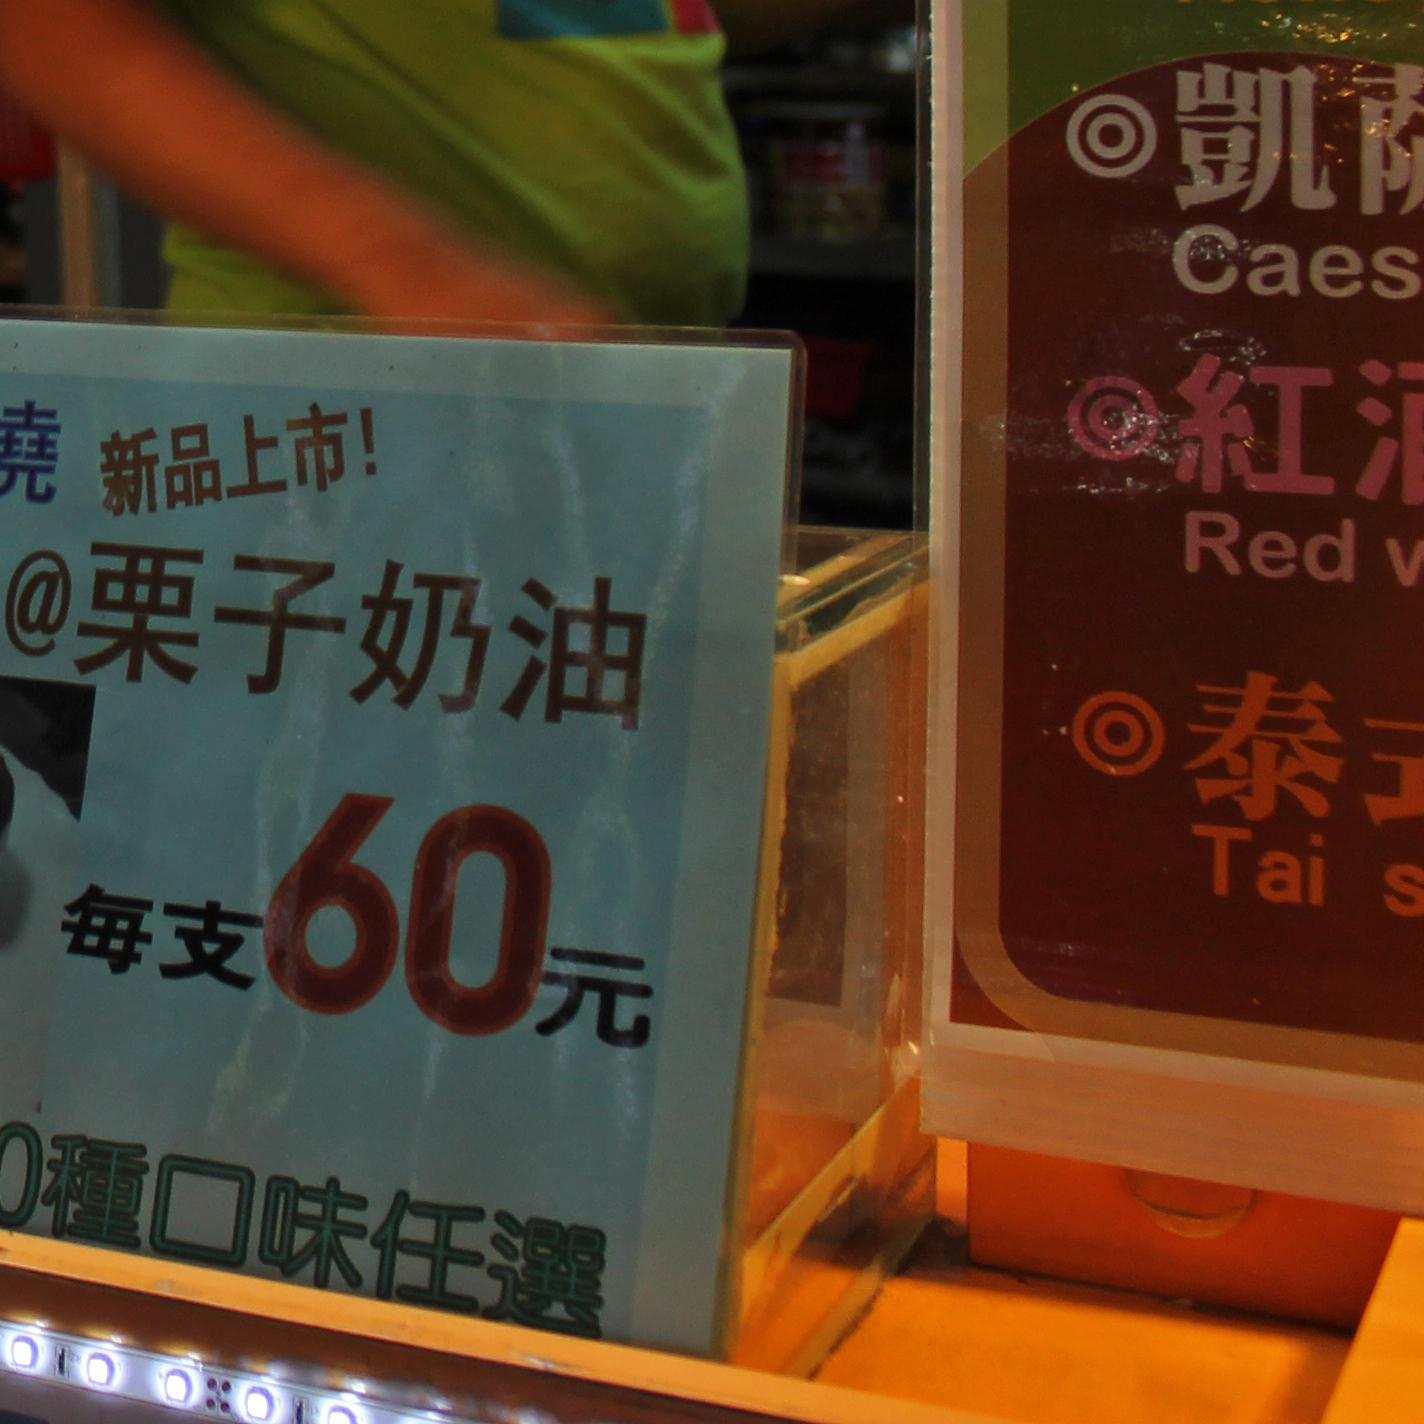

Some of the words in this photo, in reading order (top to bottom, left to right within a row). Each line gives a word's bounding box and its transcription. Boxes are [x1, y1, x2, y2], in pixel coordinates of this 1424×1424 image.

[1184, 510, 1356, 584] Red
[1191, 823, 1325, 908] Tai
[60, 792, 654, 1049] 每支60元
